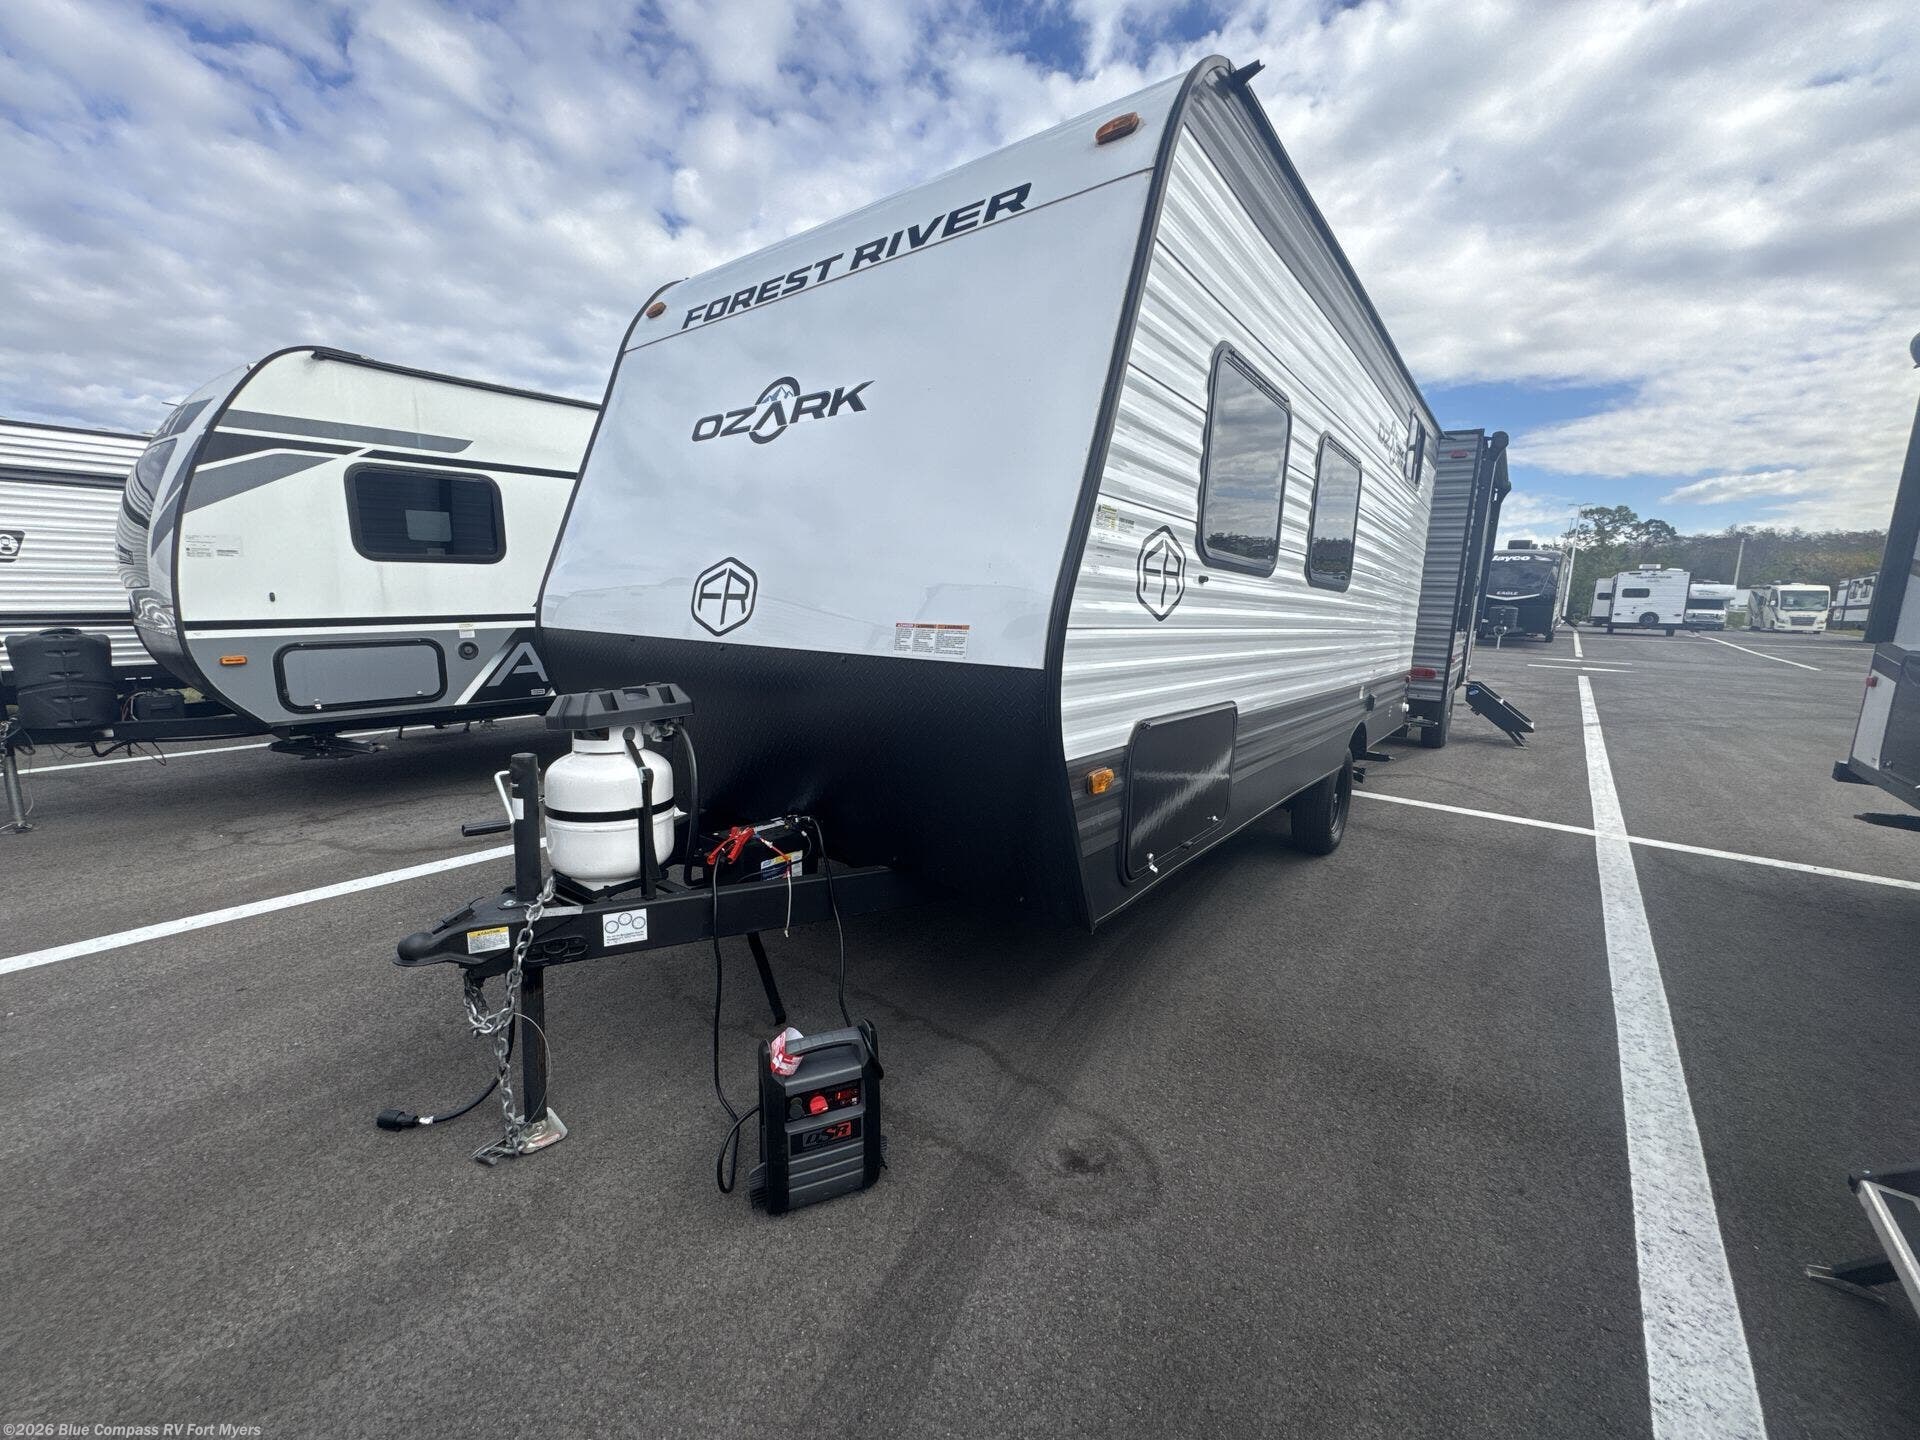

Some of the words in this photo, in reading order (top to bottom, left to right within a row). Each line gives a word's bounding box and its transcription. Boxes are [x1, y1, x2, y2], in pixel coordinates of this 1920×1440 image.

[682, 251, 844, 330] FOREST
[849, 182, 1032, 271] RIVER
[691, 376, 875, 445] OZARK
